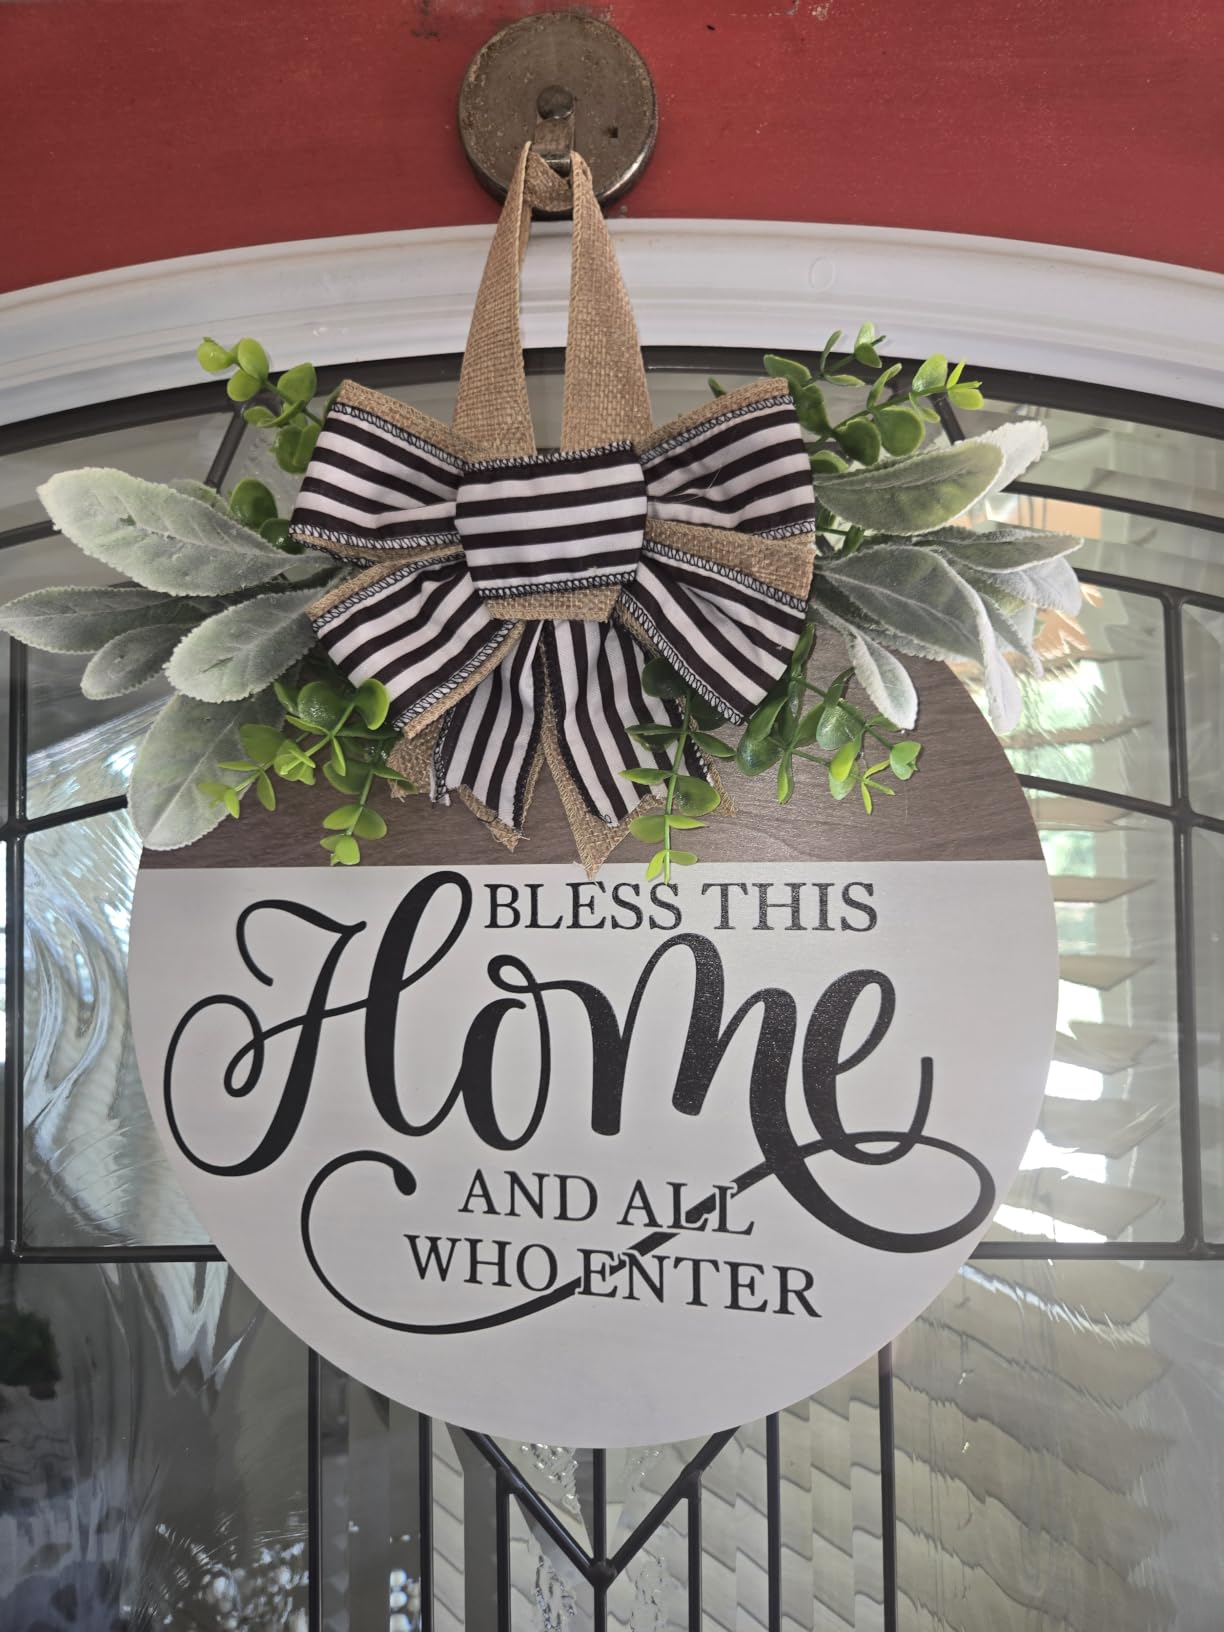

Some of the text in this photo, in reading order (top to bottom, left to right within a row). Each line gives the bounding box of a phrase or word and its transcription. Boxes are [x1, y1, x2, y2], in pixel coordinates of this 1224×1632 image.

[483, 881, 878, 933] BLESS THIS
[163, 870, 996, 1253] Home
[457, 1168, 755, 1236] AND ALL
[403, 1233, 823, 1318] WHO ENTER
